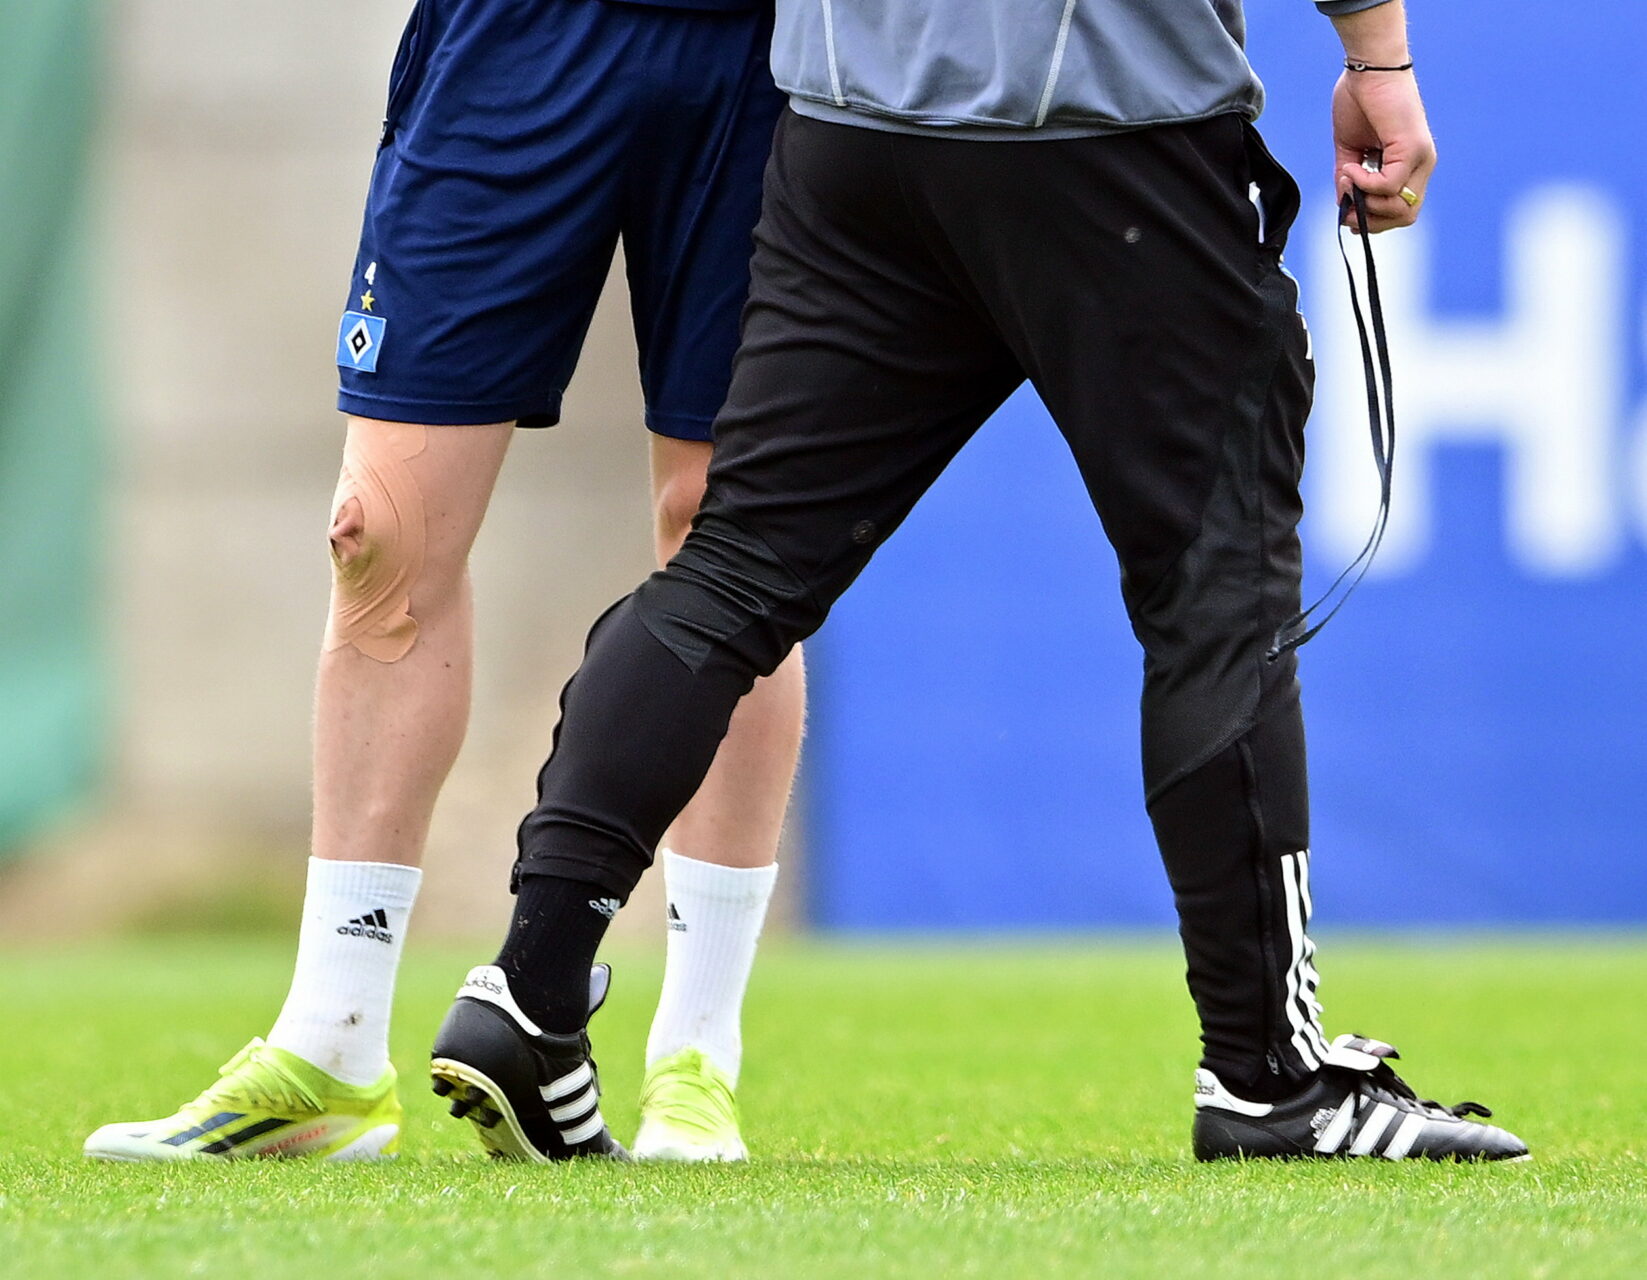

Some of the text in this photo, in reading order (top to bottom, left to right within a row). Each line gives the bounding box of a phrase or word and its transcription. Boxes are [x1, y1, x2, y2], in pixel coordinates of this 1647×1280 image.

[364, 261, 377, 286] 4
[1308, 180, 1647, 582] H
[336, 923, 393, 944] adidas
